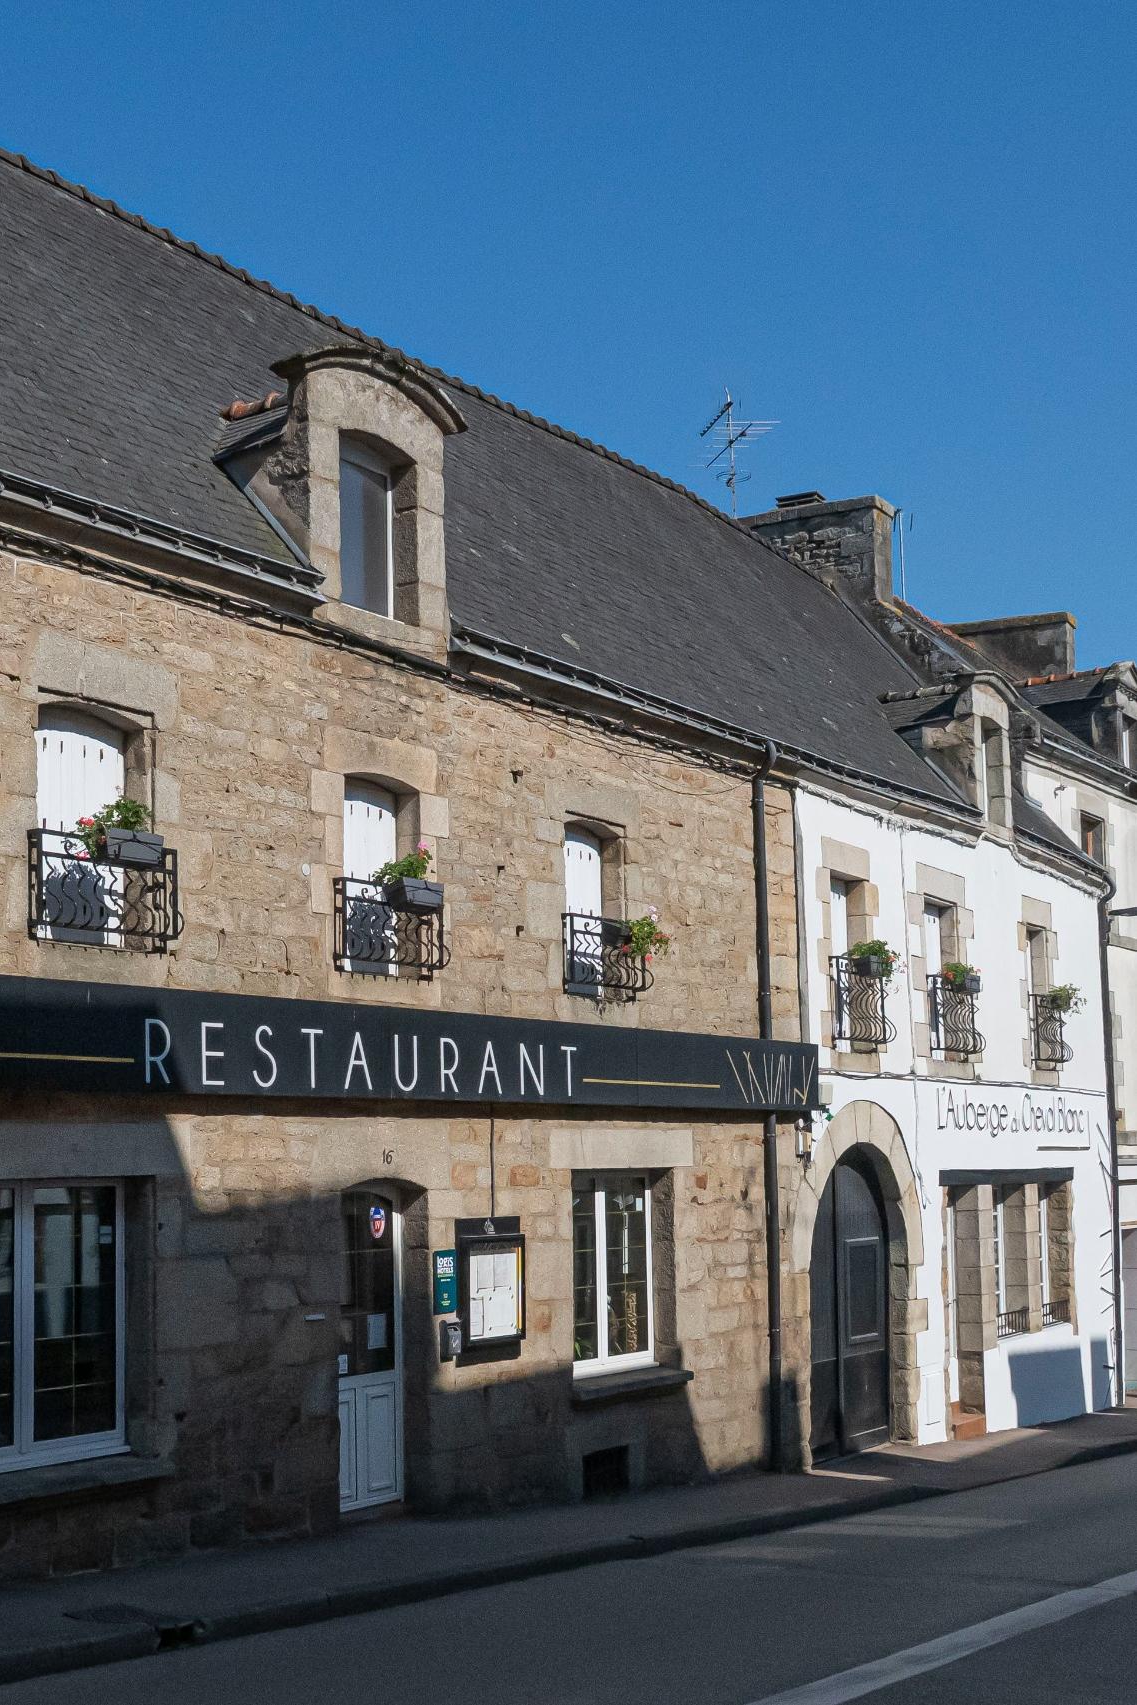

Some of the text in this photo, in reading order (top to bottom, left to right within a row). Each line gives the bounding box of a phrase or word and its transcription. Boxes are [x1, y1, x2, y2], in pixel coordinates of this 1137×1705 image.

[144, 1018, 578, 1098] RESTAURANT
[937, 1087, 1008, 1138] L'Auberge
[1021, 1092, 1056, 1133] Cheval
[1057, 1095, 1085, 1134] Blanc
[382, 1147, 395, 1165] 16
